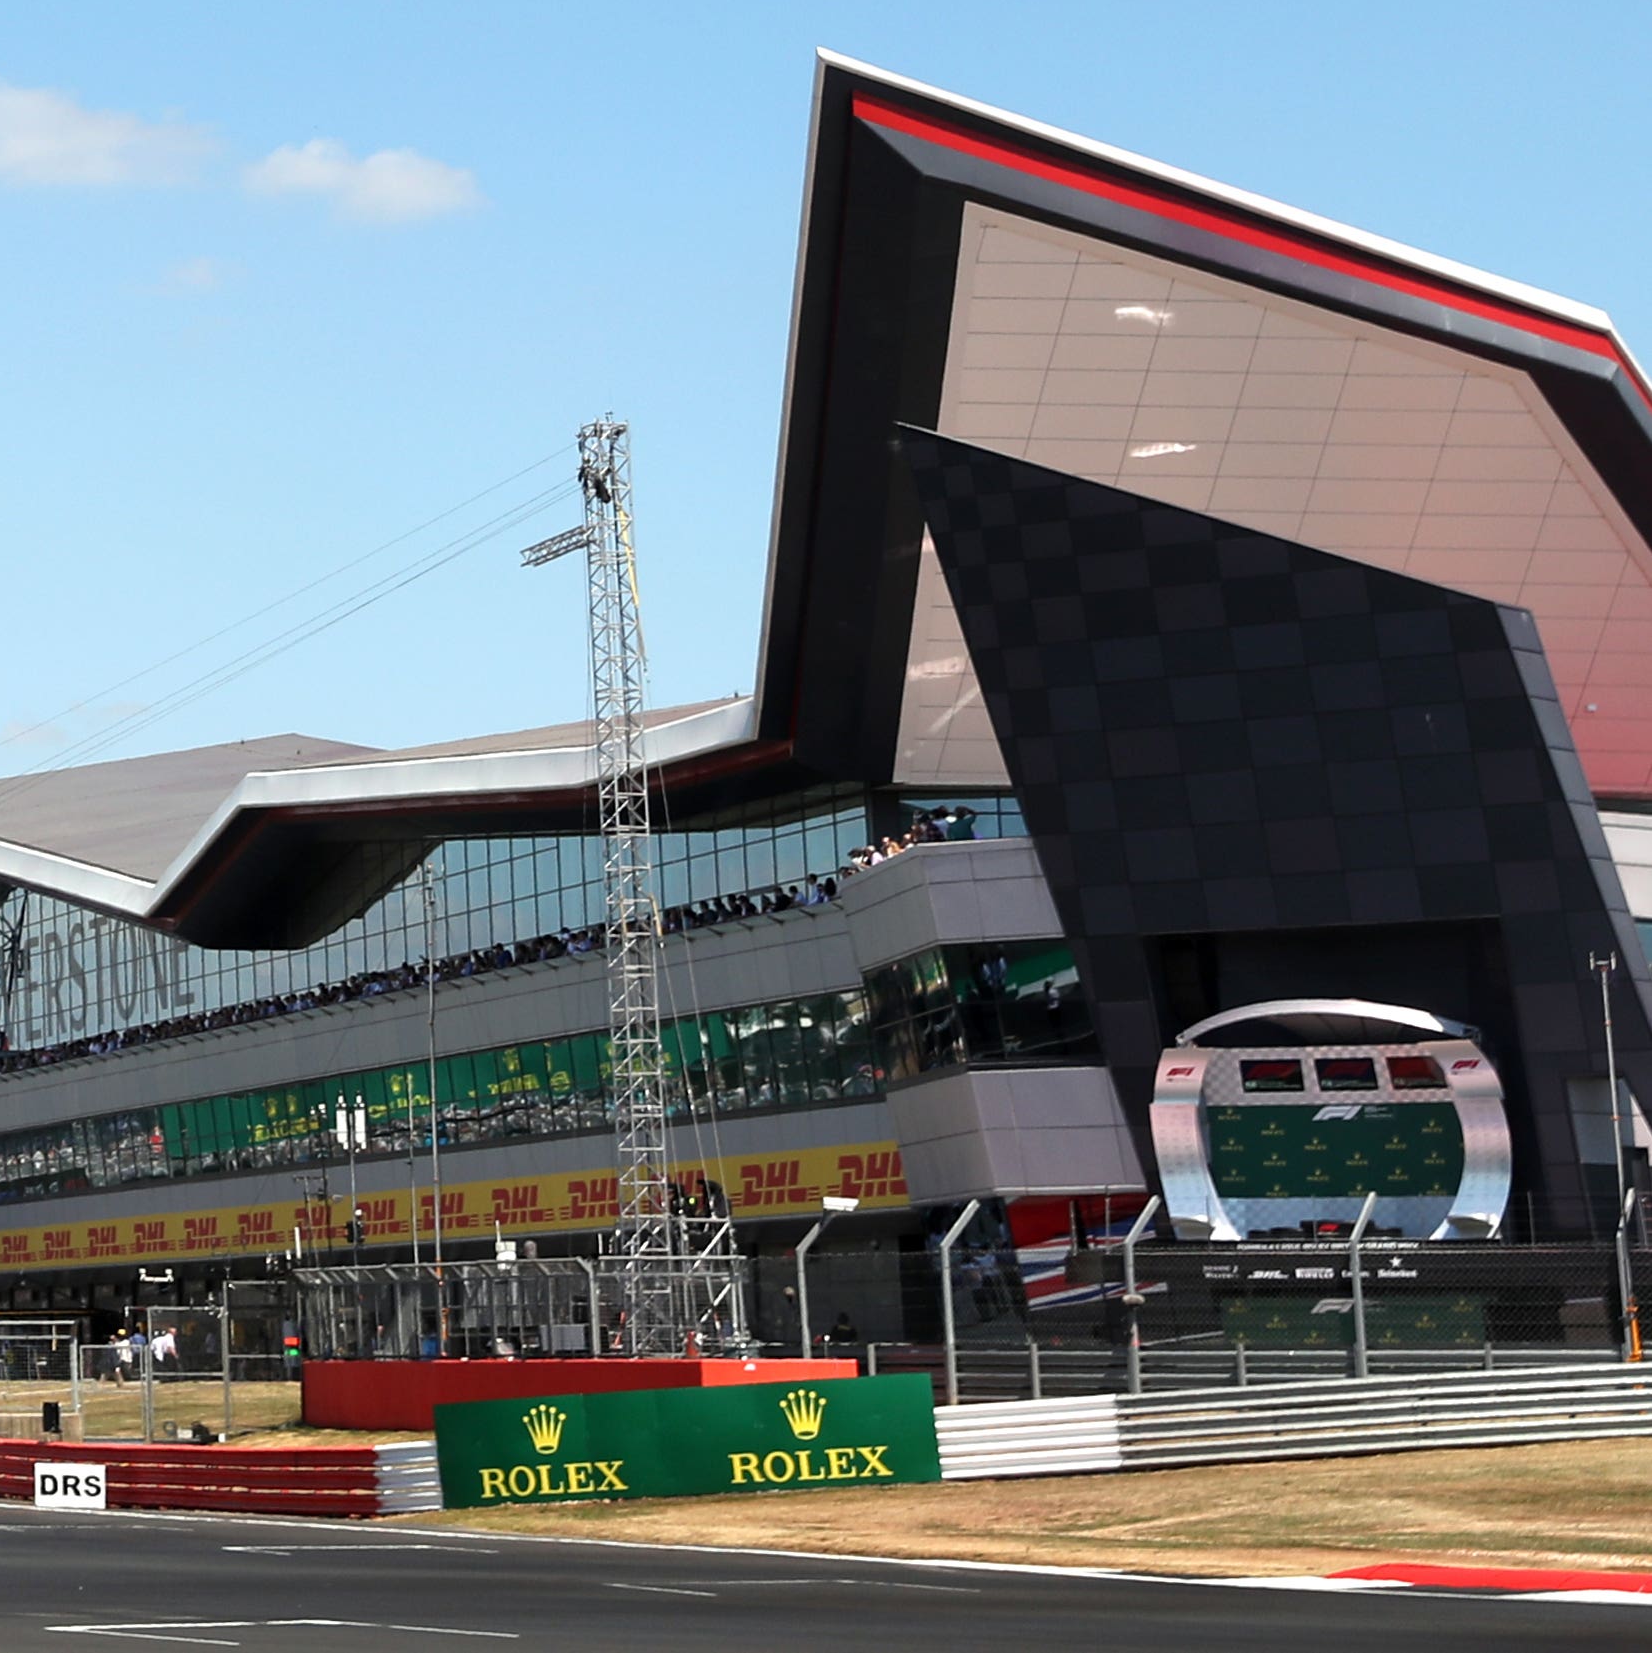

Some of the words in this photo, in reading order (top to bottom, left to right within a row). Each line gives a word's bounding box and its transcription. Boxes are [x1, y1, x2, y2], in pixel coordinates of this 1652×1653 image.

[740, 1160, 807, 1206] DHL
[838, 1151, 909, 1198] DHL
[421, 1192, 471, 1230] DHL
[492, 1185, 546, 1225] DHL
[567, 1177, 627, 1220] DHL
[134, 1221, 170, 1254] DHL
[184, 1217, 221, 1249] DHL
[238, 1212, 282, 1244] DHL
[479, 1460, 629, 1499] ROLEX
[728, 1446, 894, 1485] ROLEX
[40, 1474, 102, 1497] DRS
